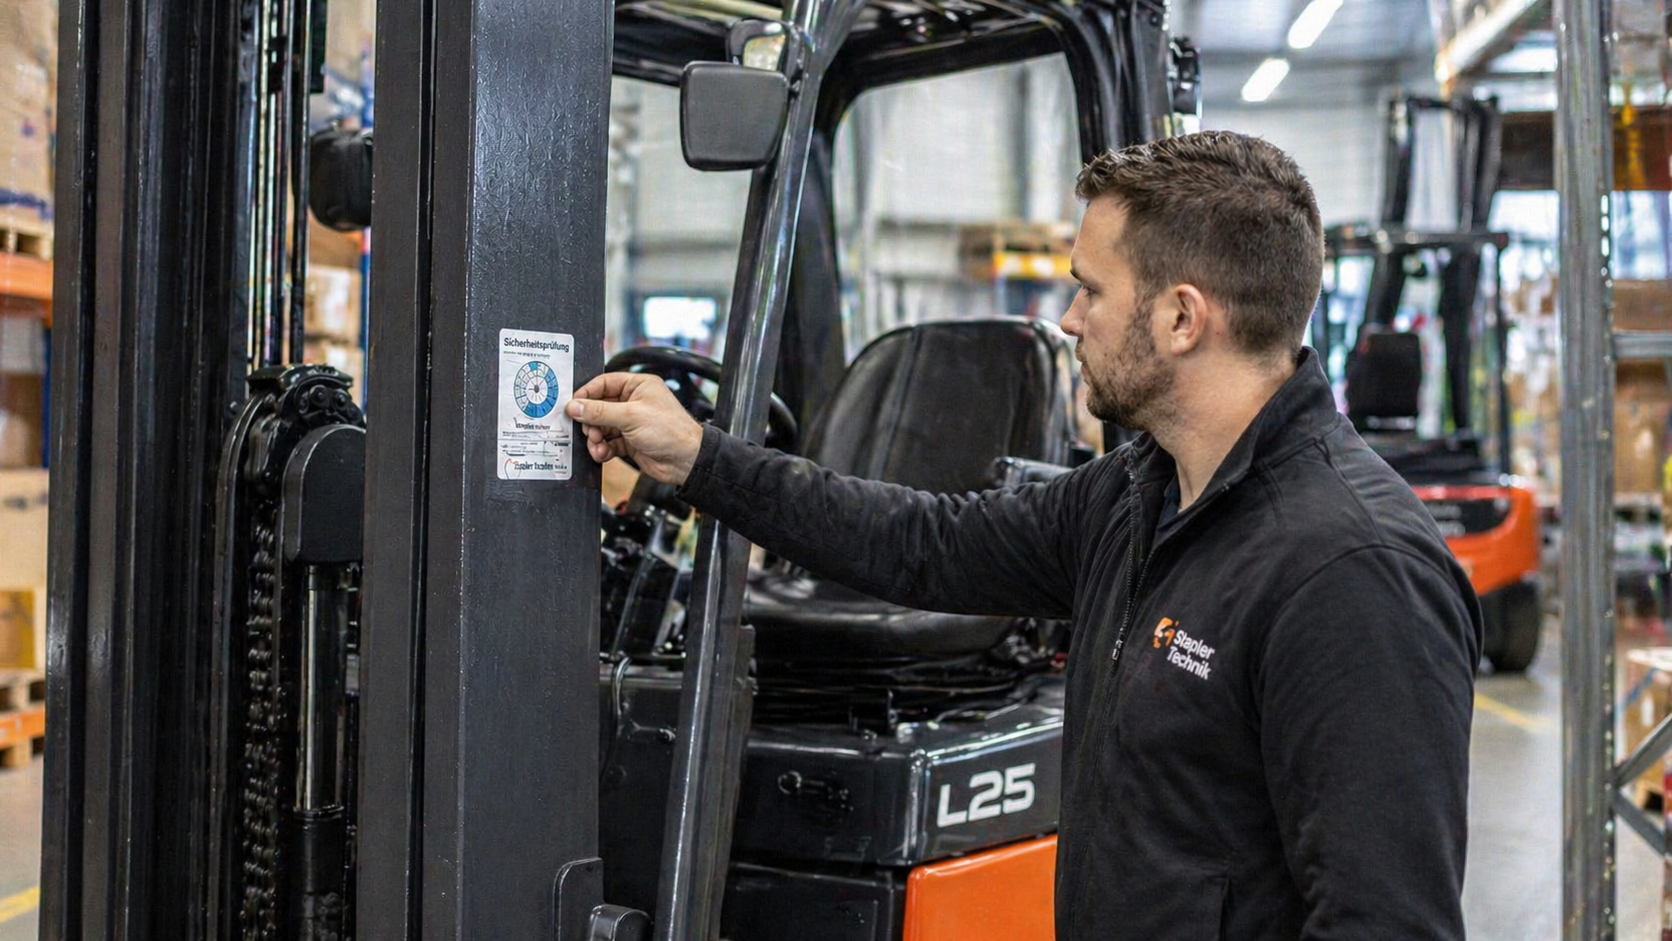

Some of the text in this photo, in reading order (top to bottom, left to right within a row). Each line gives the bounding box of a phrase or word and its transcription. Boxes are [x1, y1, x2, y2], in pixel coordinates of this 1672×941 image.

[504, 337, 569, 353] Sicherheitsprüfung
[1173, 630, 1215, 659] Stapler
[1167, 646, 1211, 680] Technik
[937, 763, 1036, 828] L25
